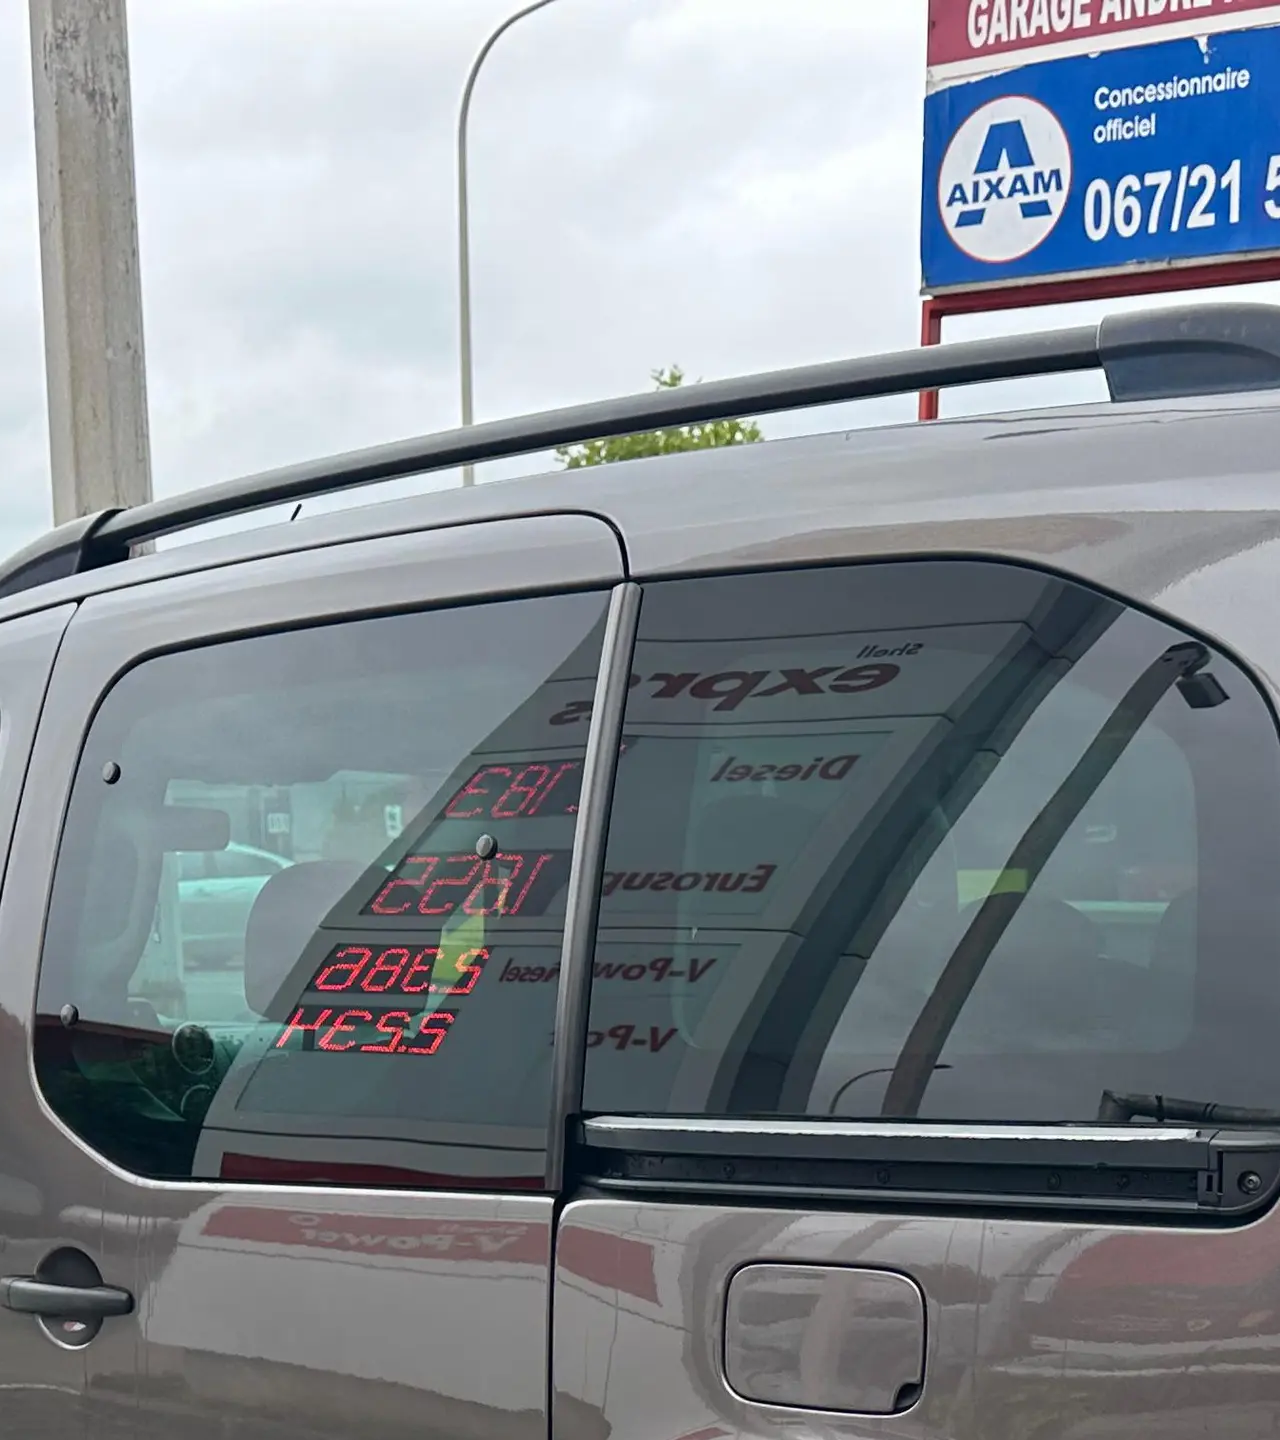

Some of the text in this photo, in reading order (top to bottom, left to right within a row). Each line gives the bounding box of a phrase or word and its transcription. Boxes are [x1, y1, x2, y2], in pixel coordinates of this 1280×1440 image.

[1093, 65, 1251, 111] Concessionnaire
[1093, 112, 1157, 144] officiel
[946, 168, 1063, 208] AIXAM
[1083, 158, 1241, 242] 067/21
